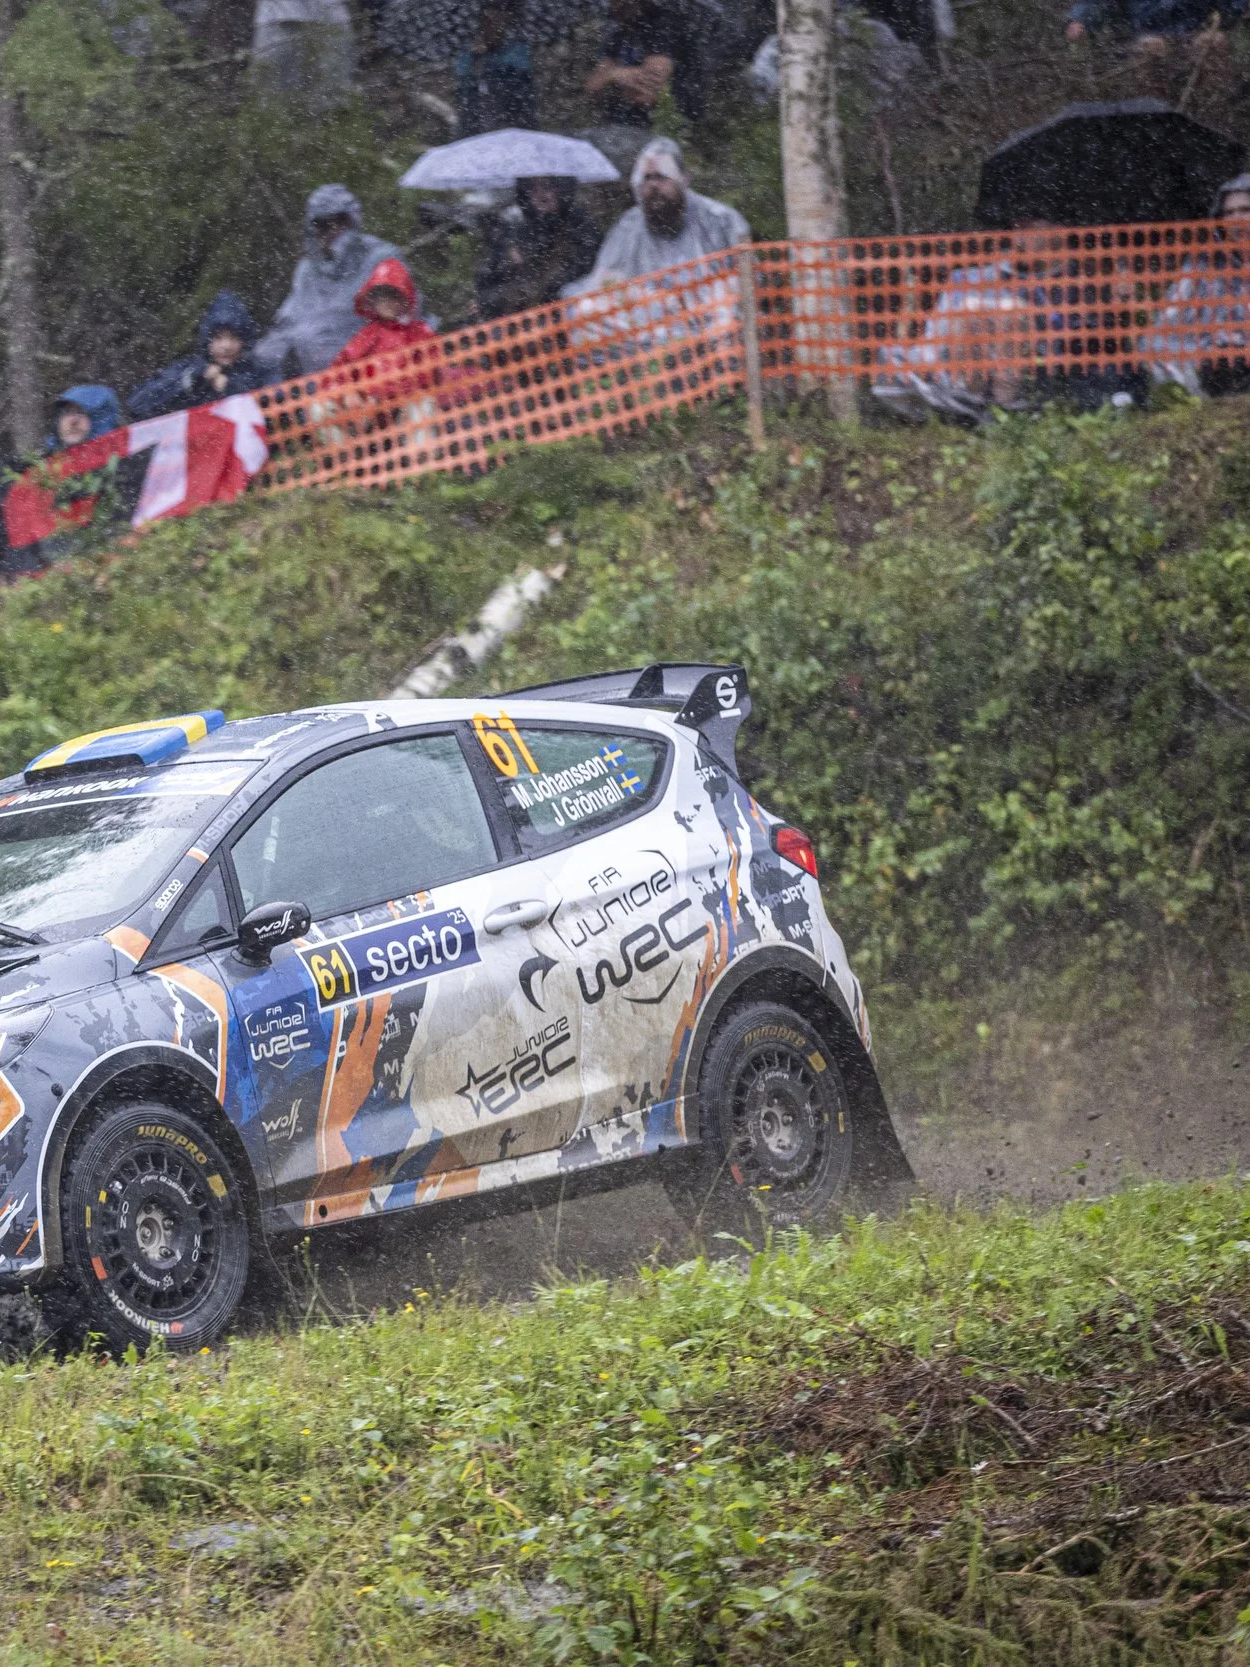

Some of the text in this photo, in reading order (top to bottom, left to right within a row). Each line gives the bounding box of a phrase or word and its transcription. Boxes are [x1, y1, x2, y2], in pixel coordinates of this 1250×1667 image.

[472, 710, 540, 779] 61
[510, 756, 609, 810] M Johansson
[551, 776, 626, 827] J Grönvall
[155, 878, 182, 910] sparco
[588, 866, 623, 895] FIA
[254, 909, 293, 936] wolf
[571, 869, 671, 948] JUNIOR
[310, 949, 350, 1000] 61
[366, 924, 462, 982] secto
[576, 898, 710, 1005] WRC
[250, 1014, 303, 1037] JUNIOR
[265, 1005, 283, 1017] FIA
[250, 1028, 311, 1062] WRC
[505, 1016, 569, 1066] JUNIOR
[479, 1032, 576, 1115] ERC
[262, 1098, 303, 1140] wolf
